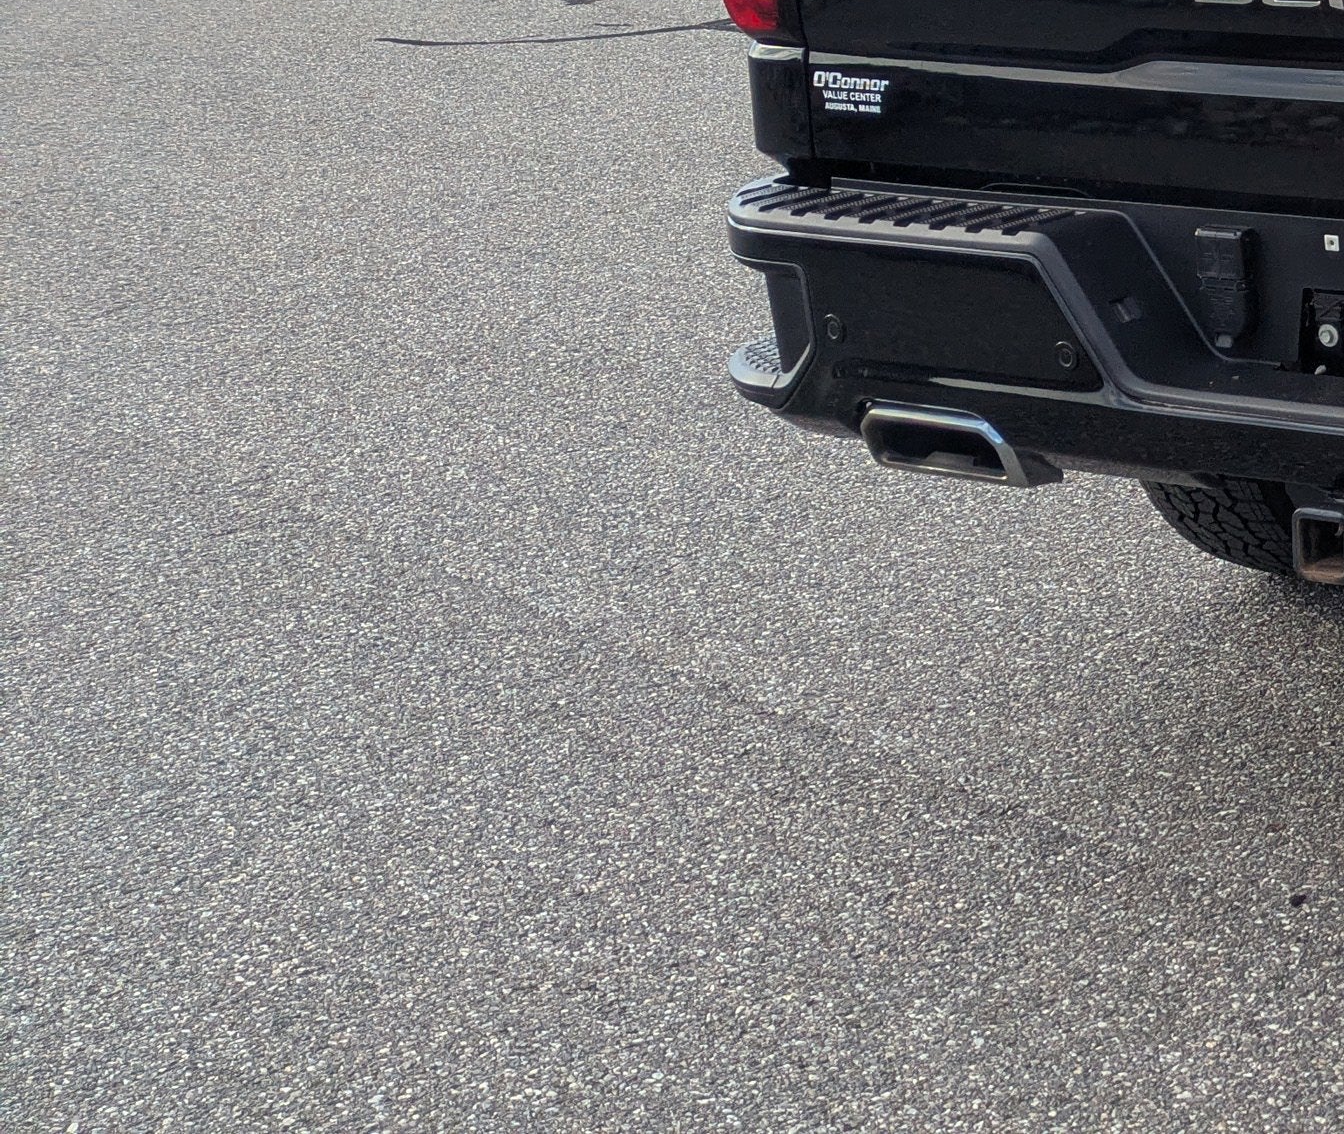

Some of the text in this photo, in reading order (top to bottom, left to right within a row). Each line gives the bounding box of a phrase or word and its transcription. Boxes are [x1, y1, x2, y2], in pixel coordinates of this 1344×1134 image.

[813, 71, 889, 91] O'Connor
[822, 90, 882, 102] VALUE CENTER
